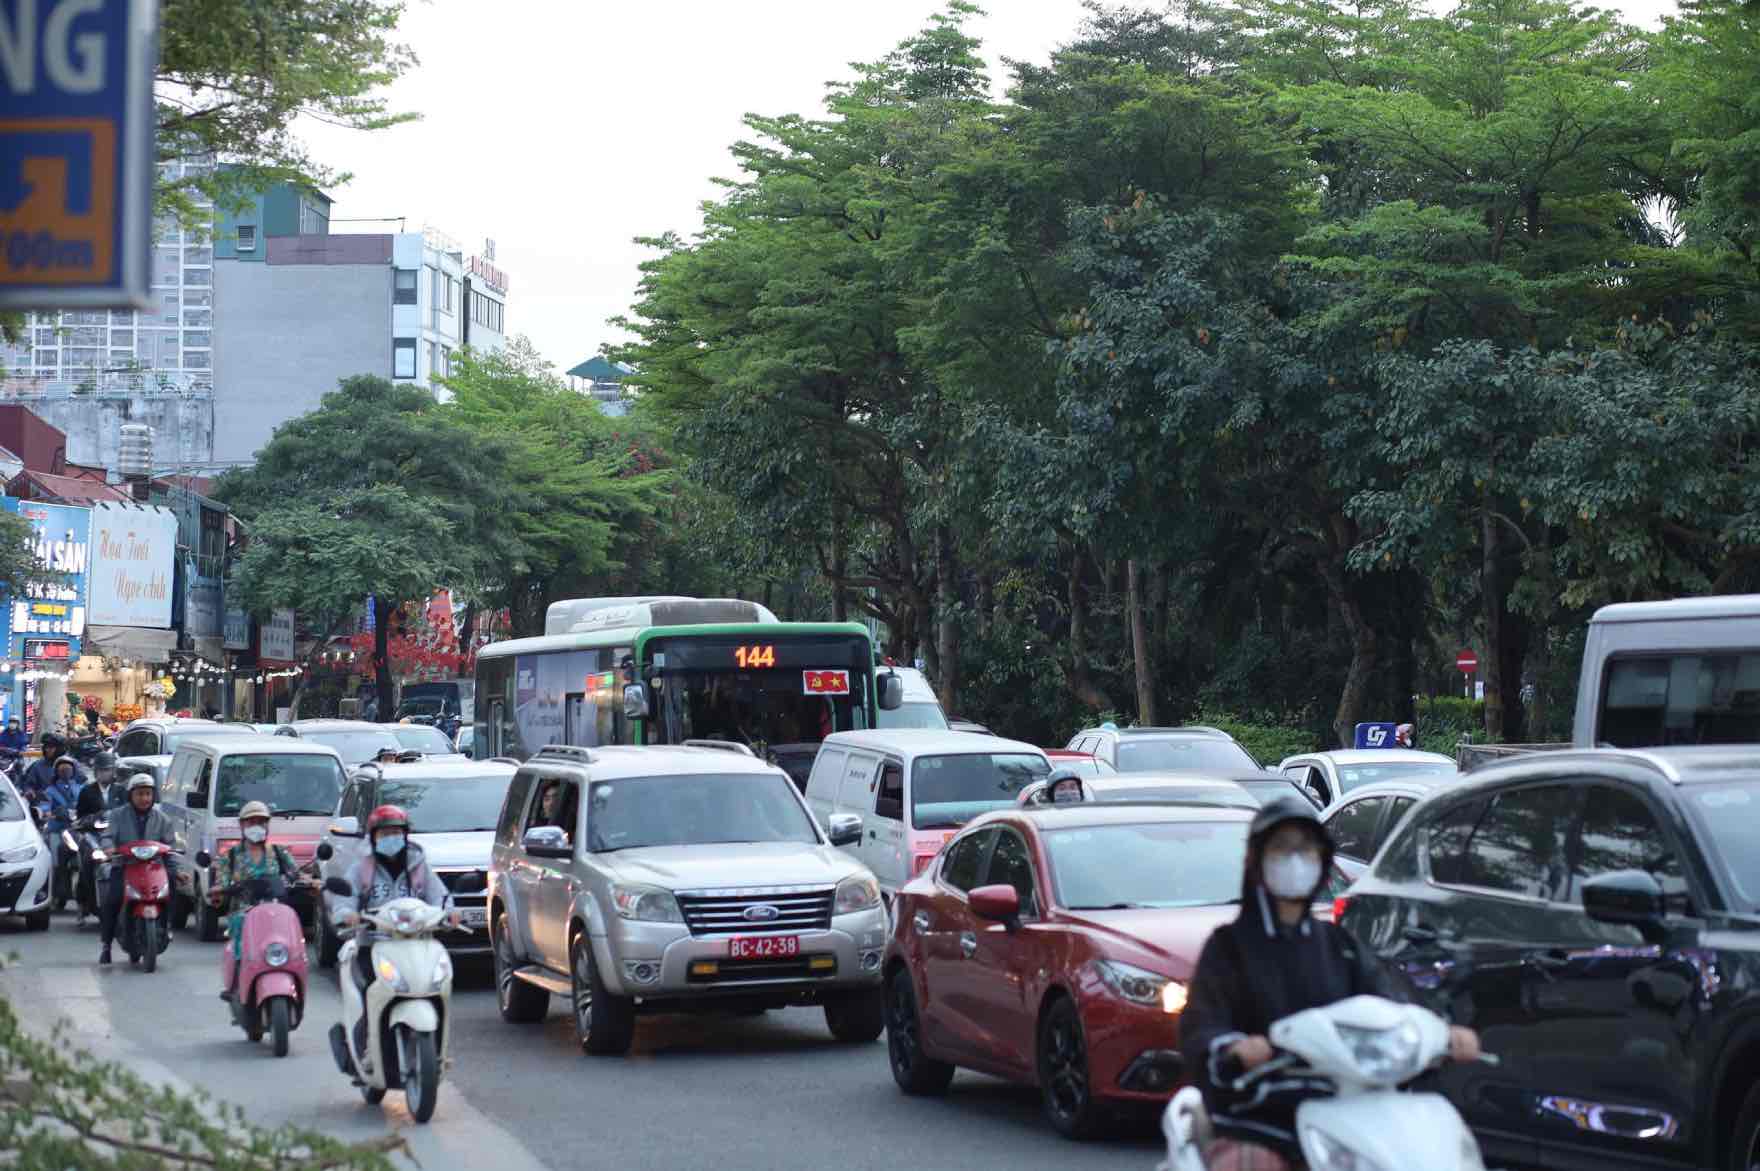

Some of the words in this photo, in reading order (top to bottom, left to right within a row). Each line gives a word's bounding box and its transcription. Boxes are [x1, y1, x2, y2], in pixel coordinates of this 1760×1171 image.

[0, 230, 93, 271] 00m
[54, 527, 86, 573] SẢN
[735, 645, 775, 668] 144
